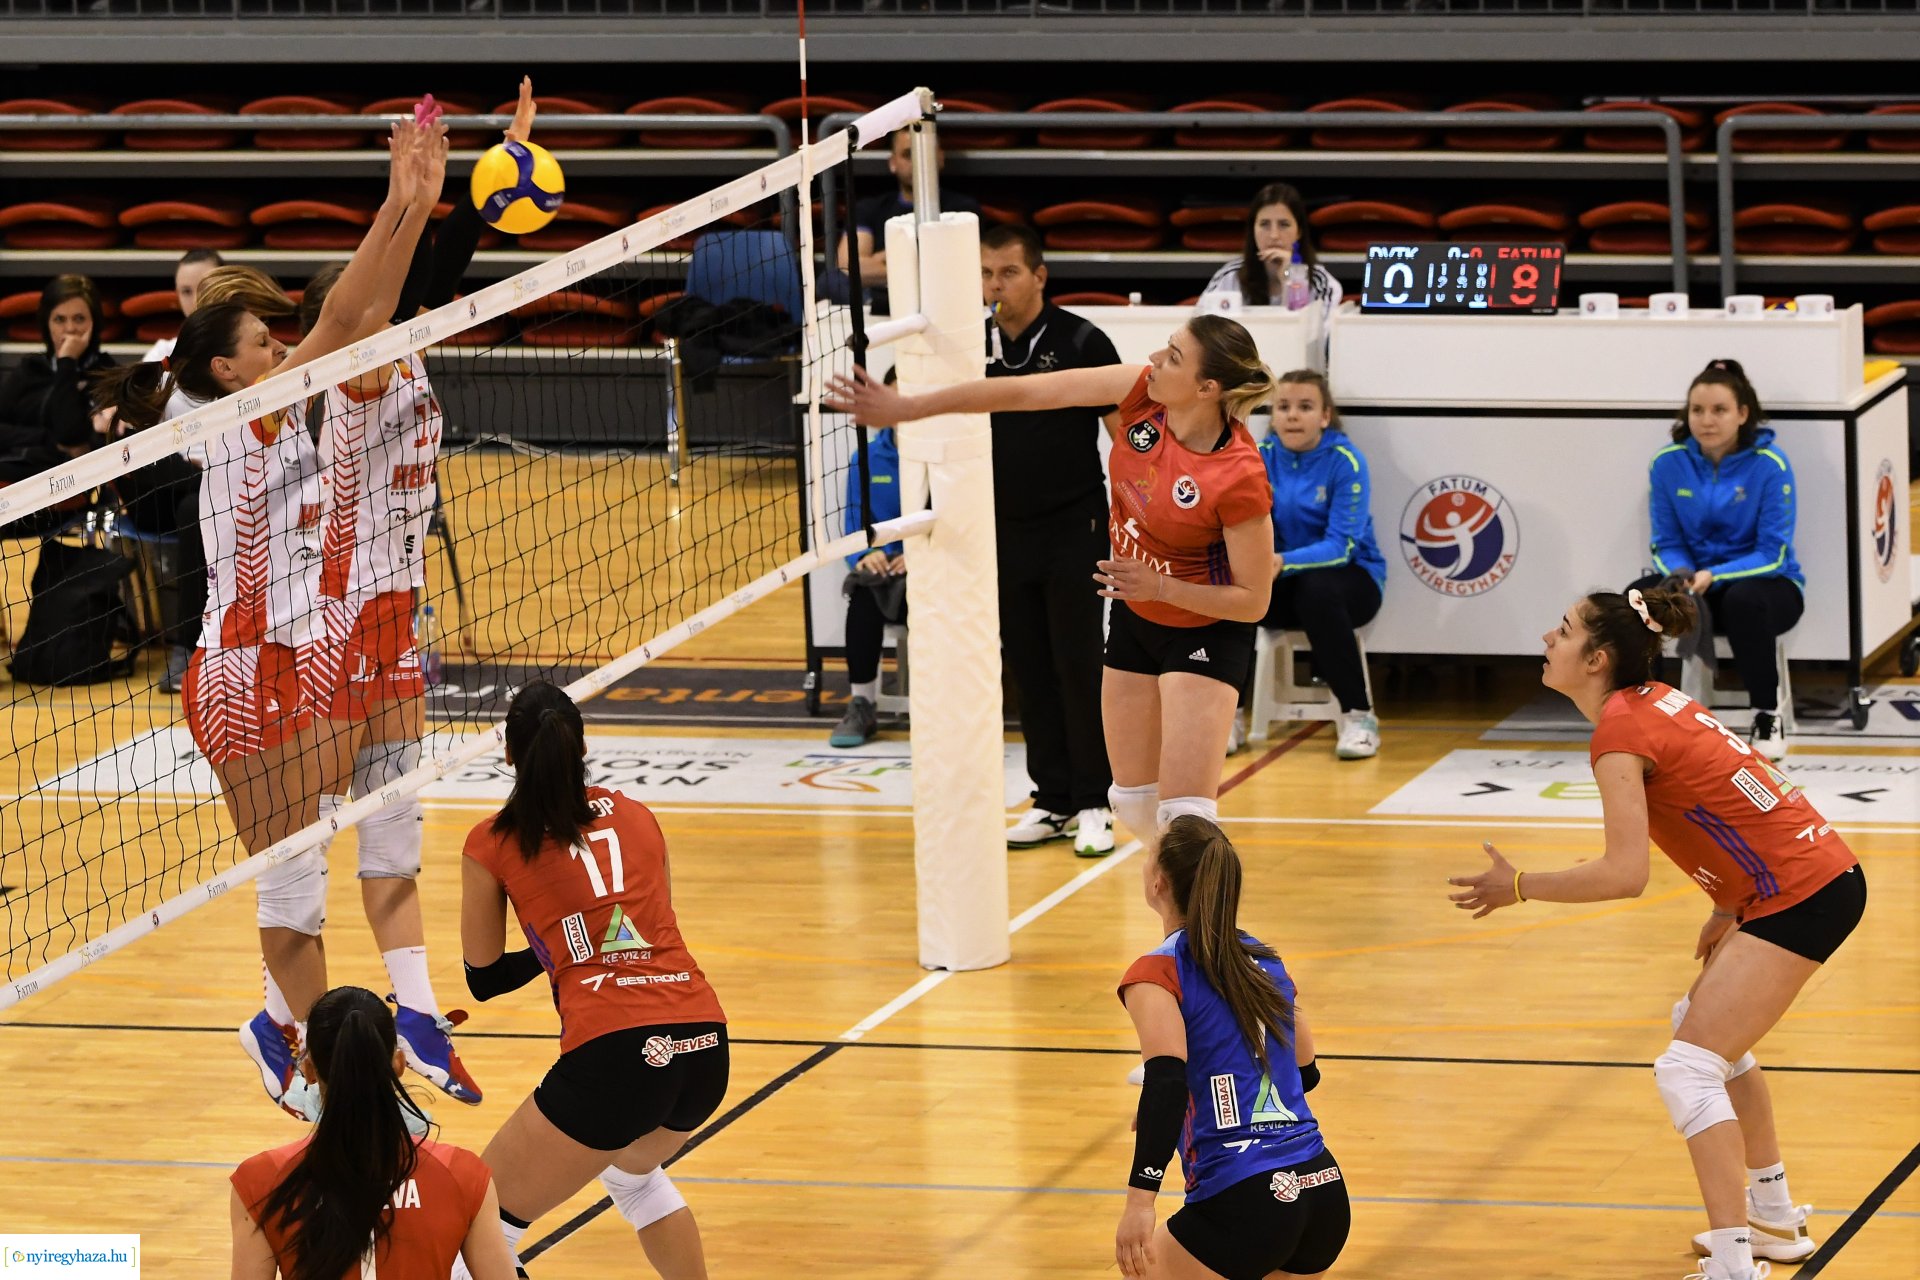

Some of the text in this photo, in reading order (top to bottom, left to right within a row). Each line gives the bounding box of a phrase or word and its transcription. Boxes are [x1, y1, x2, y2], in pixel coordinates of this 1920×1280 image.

[237, 397, 261, 417] FATUM
[49, 474, 76, 496] FATUM
[1429, 479, 1487, 495] FATUM
[1109, 513, 1173, 576] ATUM
[1695, 712, 1751, 755] 3
[1738, 773, 1773, 807] STRABAG
[590, 797, 615, 817] OP
[568, 827, 625, 899] 17
[569, 917, 588, 960] STRABAG
[15, 980, 39, 1000] FATUM
[615, 972, 691, 987] BESTRONG
[673, 1033, 718, 1053] REVESZ
[1218, 1077, 1233, 1126] STRABAG
[1300, 1167, 1341, 1188] REVESZ
[392, 1178, 421, 1209] VA
